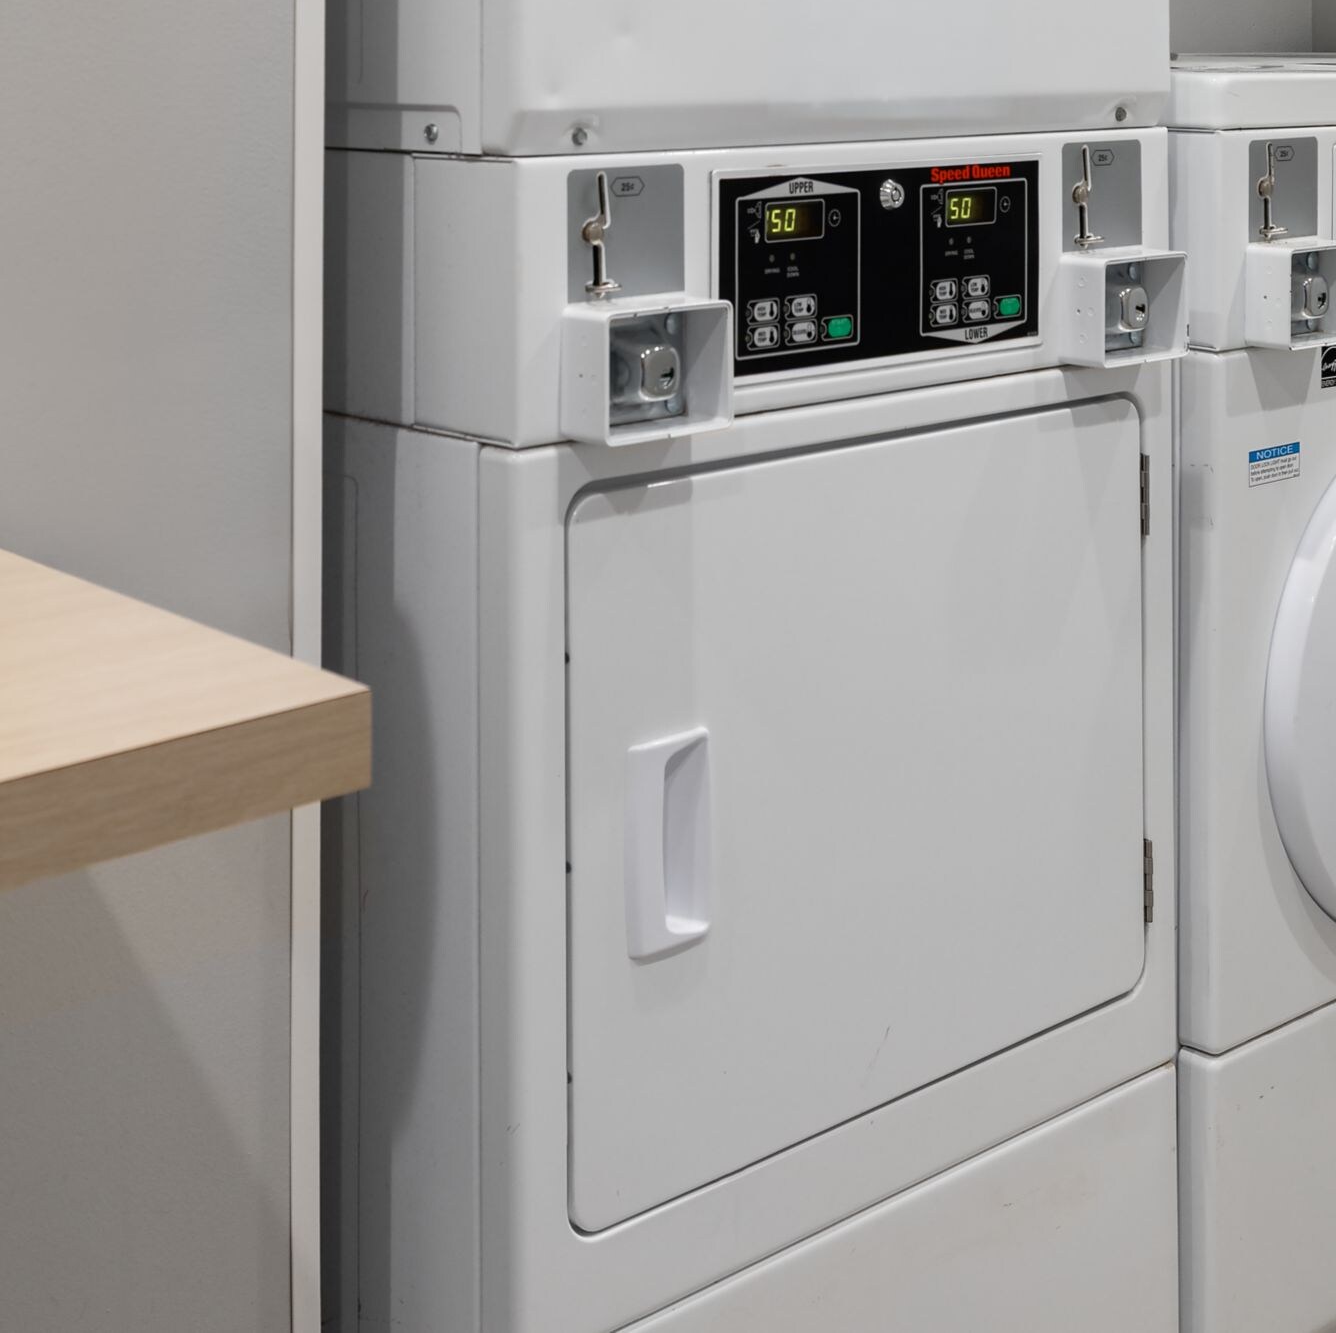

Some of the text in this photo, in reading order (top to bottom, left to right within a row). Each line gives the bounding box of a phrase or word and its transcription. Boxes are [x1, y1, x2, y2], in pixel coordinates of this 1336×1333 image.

[930, 163, 1011, 184] Speed Queen
[789, 181, 813, 194] UPPER
[950, 197, 971, 219] 50
[964, 327, 988, 340] LOWER
[1256, 445, 1293, 460] NOTICE
